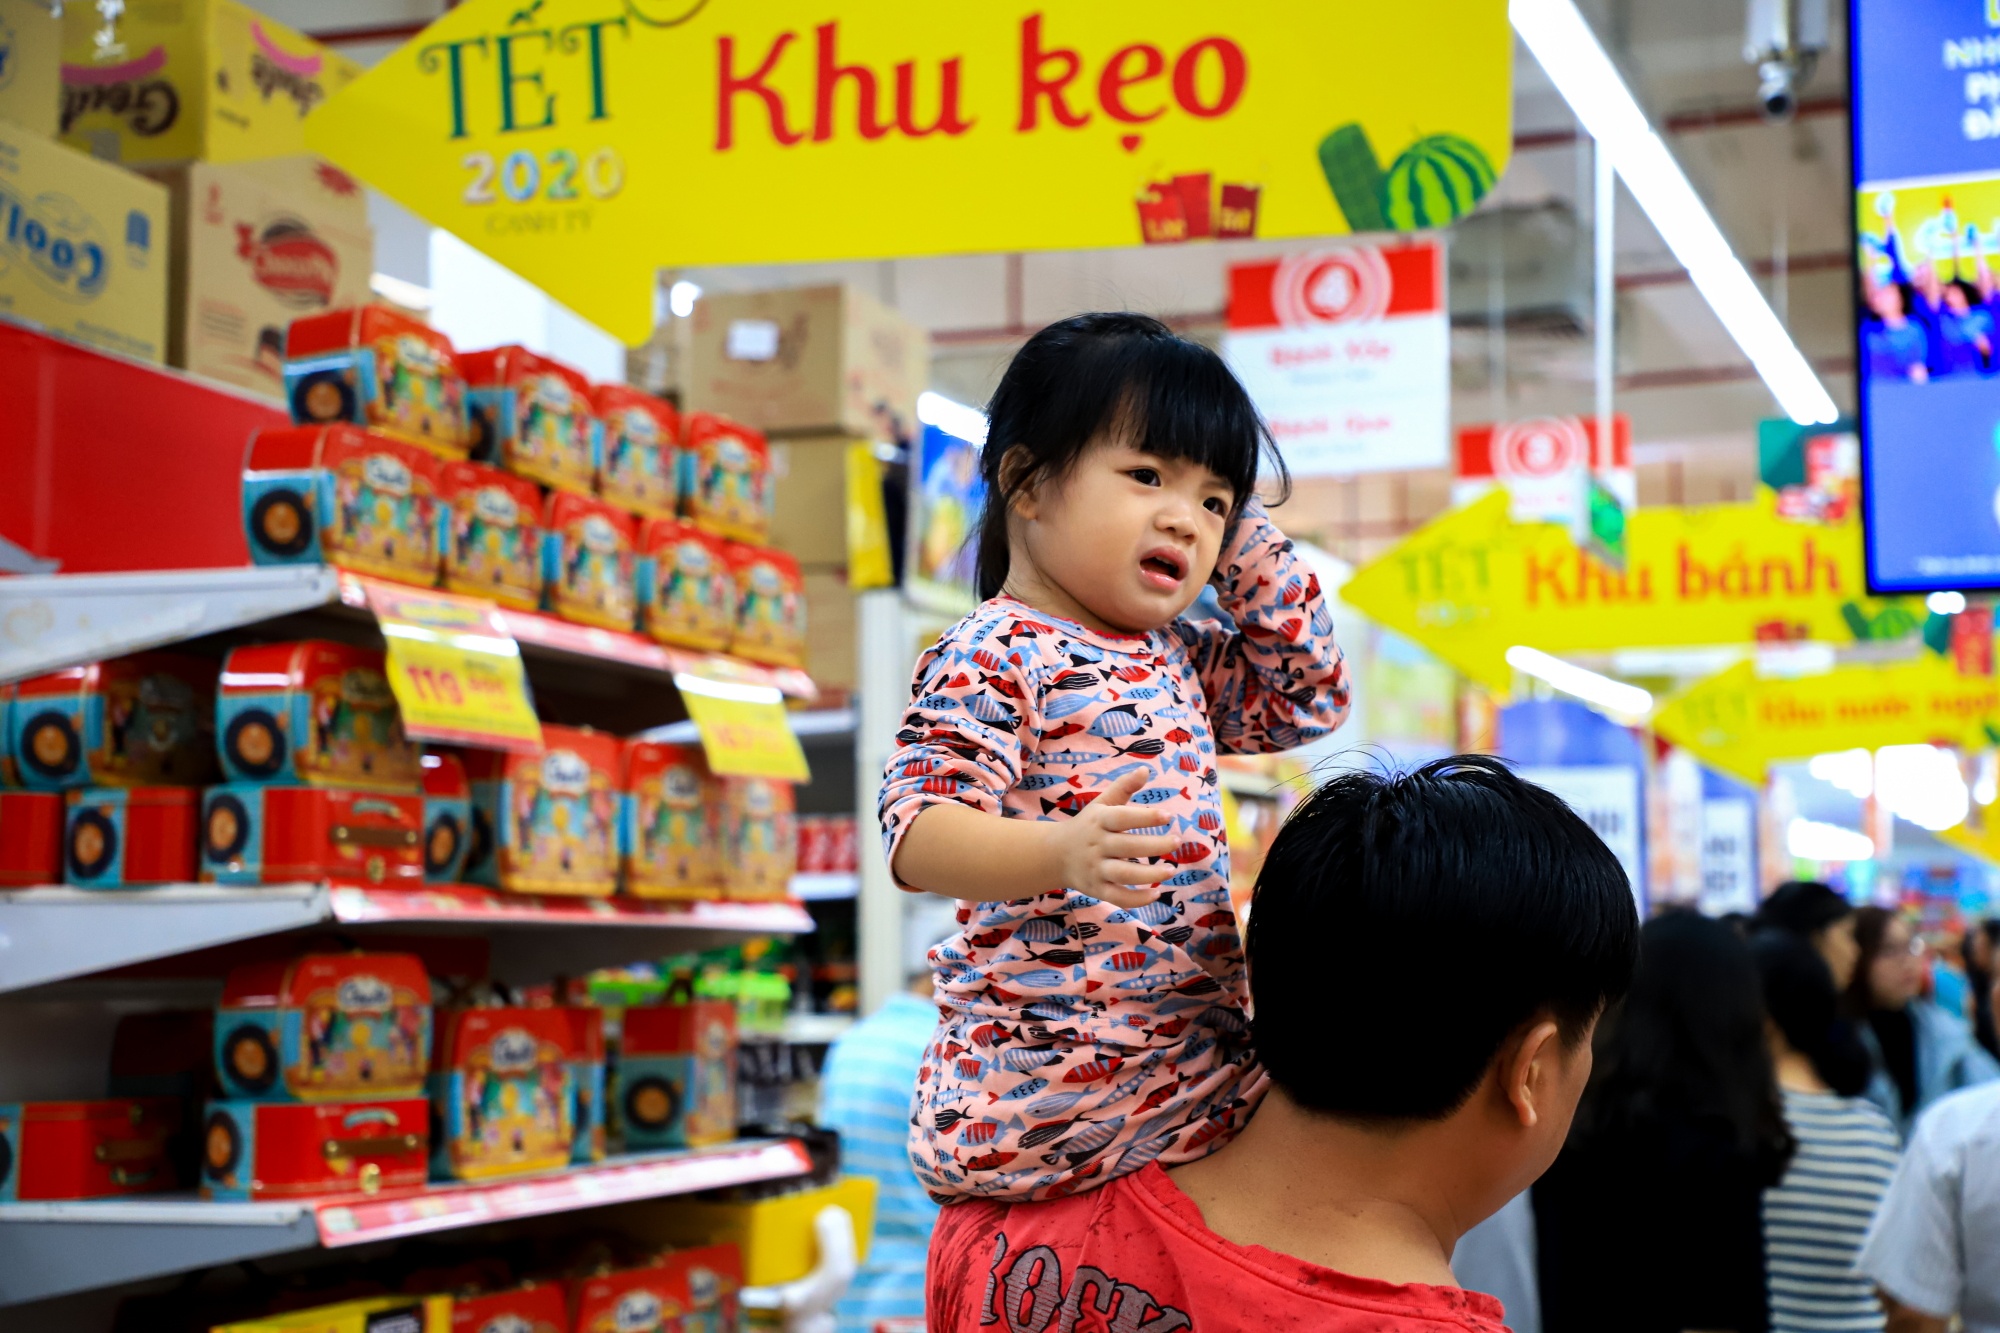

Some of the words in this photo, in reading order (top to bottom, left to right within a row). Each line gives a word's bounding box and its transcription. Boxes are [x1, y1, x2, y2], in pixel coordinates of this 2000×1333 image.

[417, 0, 630, 141] TẾT
[714, 20, 976, 152] Khu
[1016, 11, 1248, 154] kẹo
[460, 148, 625, 205] 2020
[1676, 535, 1843, 601] bánh
